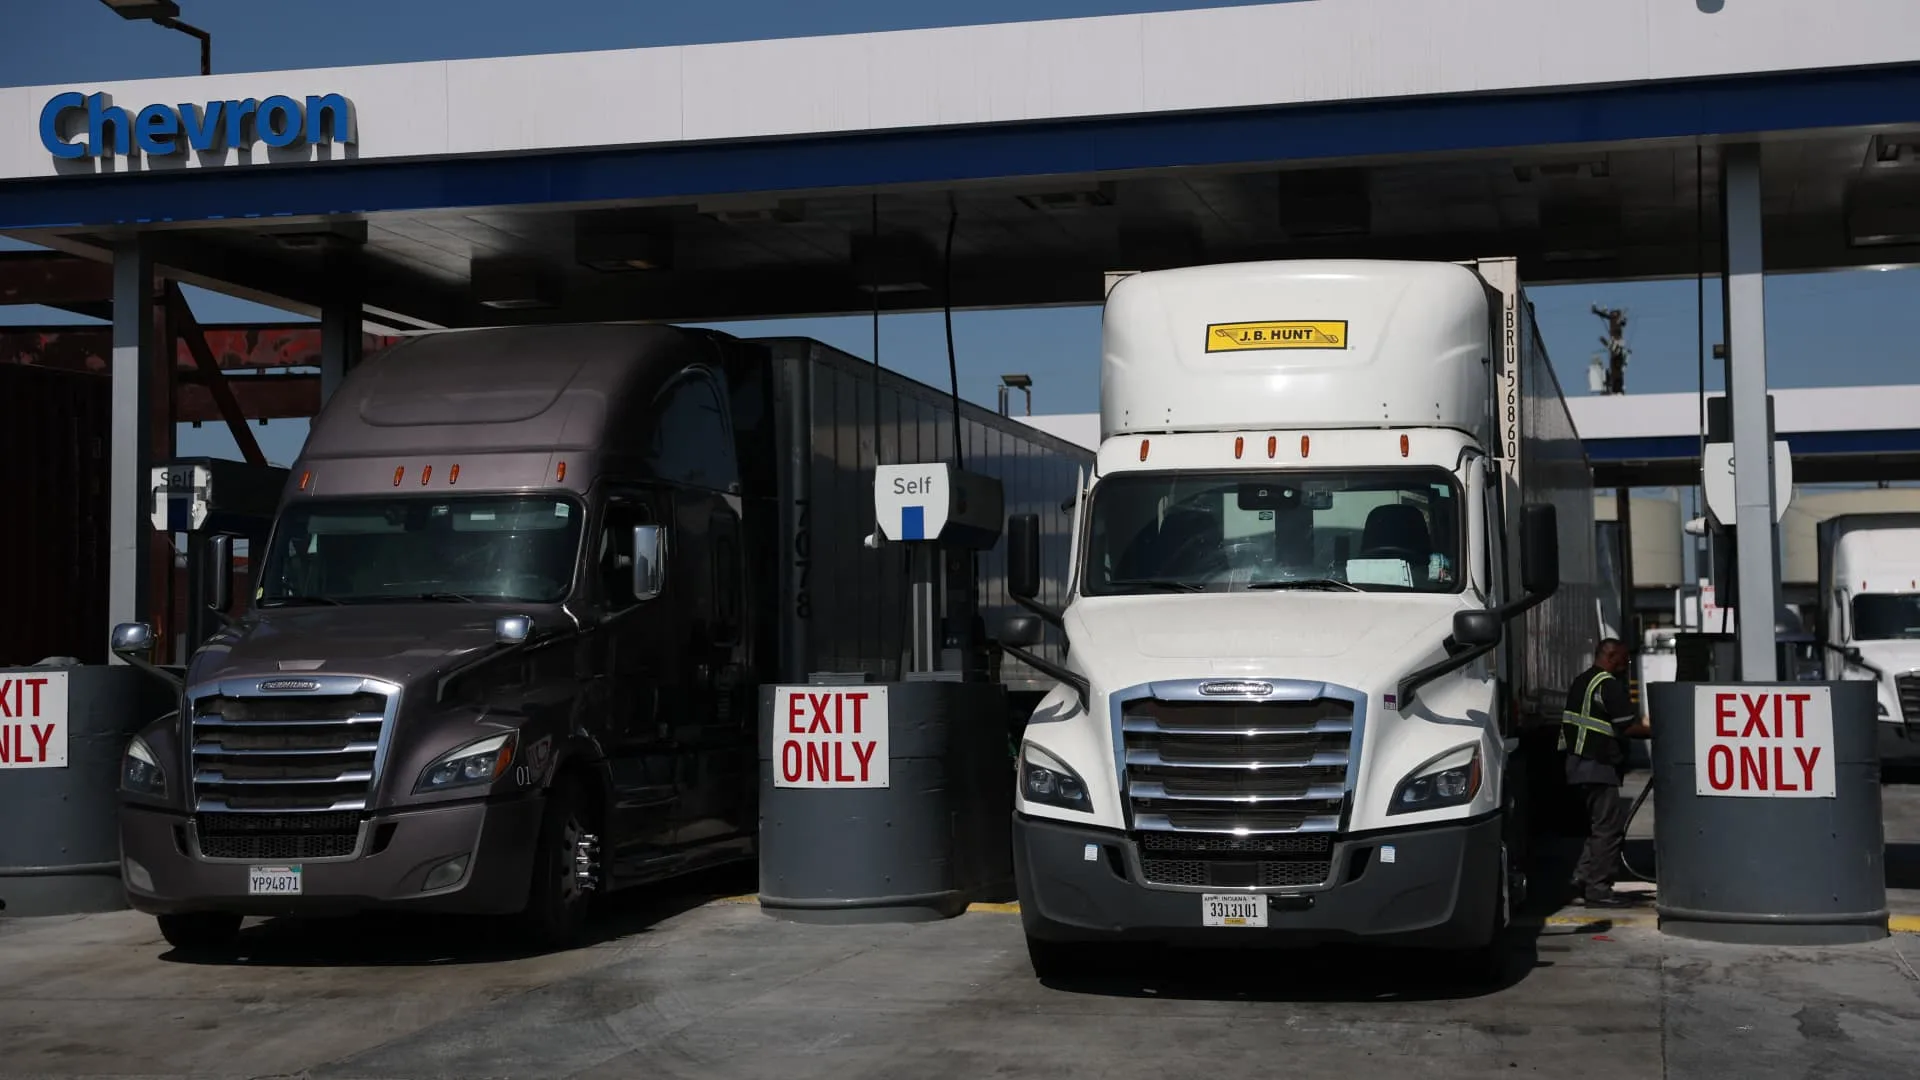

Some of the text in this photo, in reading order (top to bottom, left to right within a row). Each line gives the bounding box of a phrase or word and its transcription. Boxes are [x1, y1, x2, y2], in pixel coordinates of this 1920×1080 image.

[39, 91, 350, 160] Chevron
[1240, 329, 1314, 341] J. B. HUNT
[1505, 293, 1516, 476] JBRU 568607
[160, 471, 195, 488] Self
[893, 476, 932, 494] Self
[795, 499, 812, 619] 7078
[788, 693, 869, 734] EXIT
[1715, 693, 1811, 738] EXIT
[516, 766, 531, 786] 01
[782, 740, 877, 782] ONLY
[1707, 744, 1822, 791] ONLY
[252, 876, 299, 890] YP94871
[1210, 902, 1258, 918] 3313101
